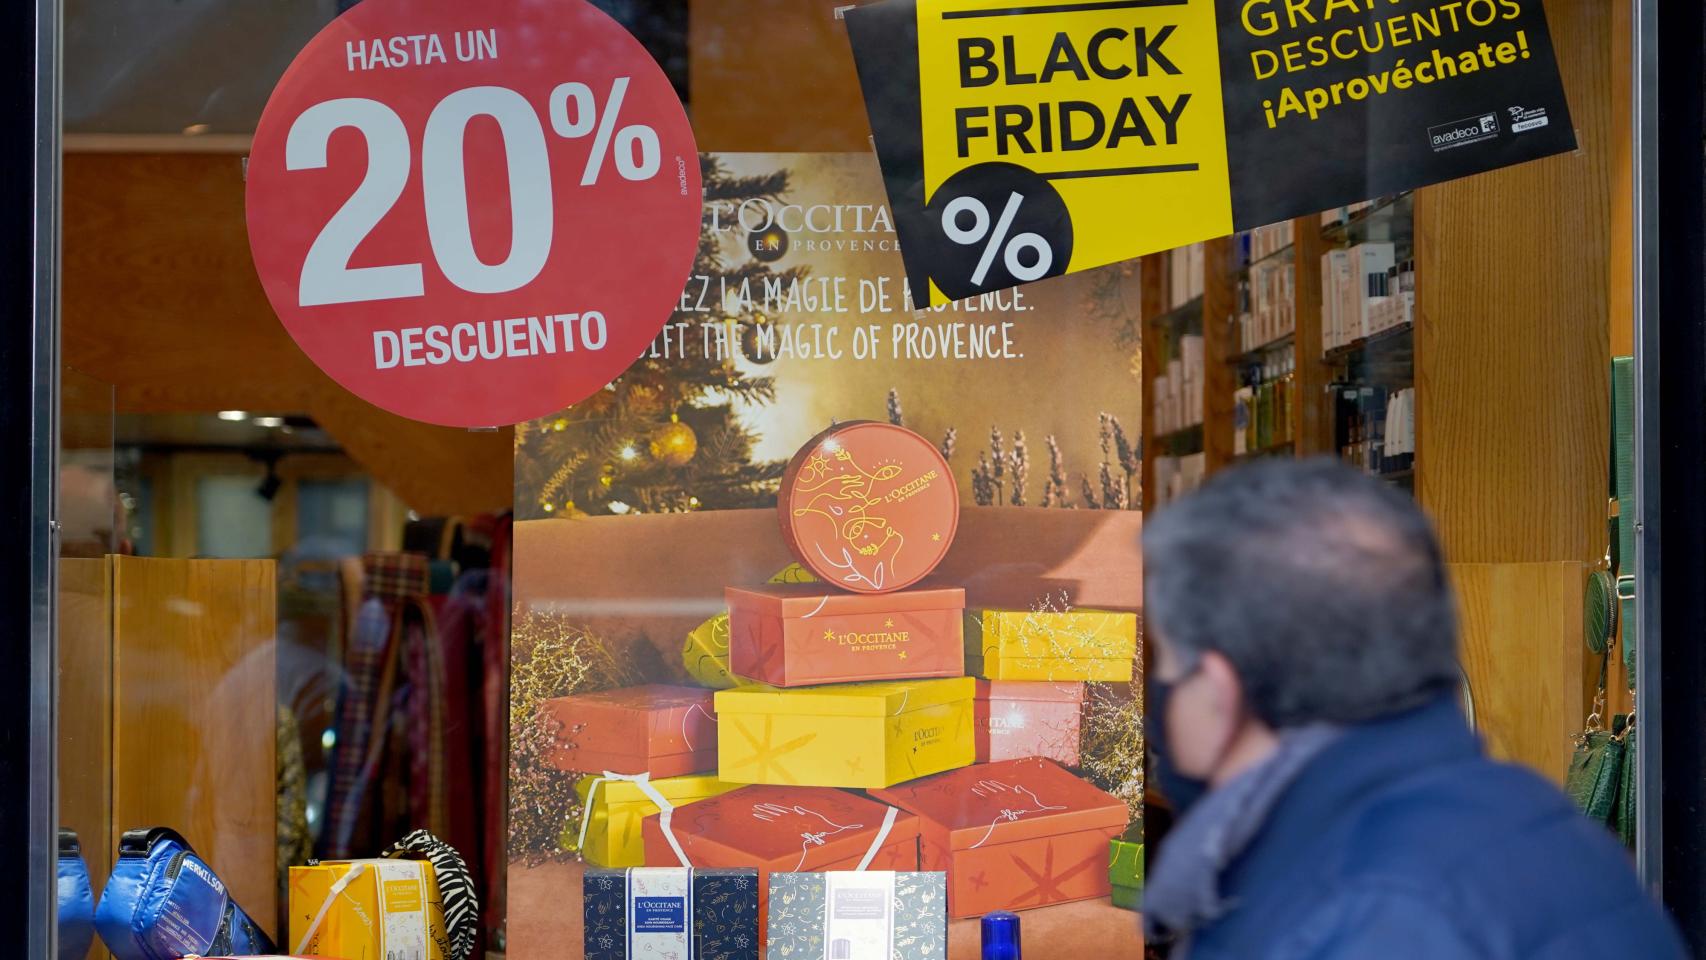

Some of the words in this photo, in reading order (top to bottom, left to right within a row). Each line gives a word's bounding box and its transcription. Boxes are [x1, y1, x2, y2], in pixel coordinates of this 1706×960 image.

[345, 31, 447, 72] HASTA
[454, 28, 498, 62] UN
[957, 25, 1183, 89] BLACK
[1250, 0, 1521, 81] DESCUENTOS
[1262, 30, 1531, 129] ¡Aprovéchate!
[955, 93, 1193, 158] FRIDAY
[1432, 126, 1479, 145] avadeco
[285, 76, 662, 307] 20%
[755, 239, 780, 251] EN
[720, 276, 754, 313] LA
[763, 276, 847, 313] MAGIE
[859, 277, 892, 313] DE
[373, 310, 608, 370] DESCUENTO
[700, 322, 744, 361] THE
[757, 322, 843, 360] MAGIC
[852, 322, 881, 360] OF
[892, 321, 1025, 360] PROVENCE.
[884, 469, 939, 503] L'OCCITANE
[838, 631, 910, 646] L'OCCITANE
[637, 901, 682, 909] L'OCCITANE
